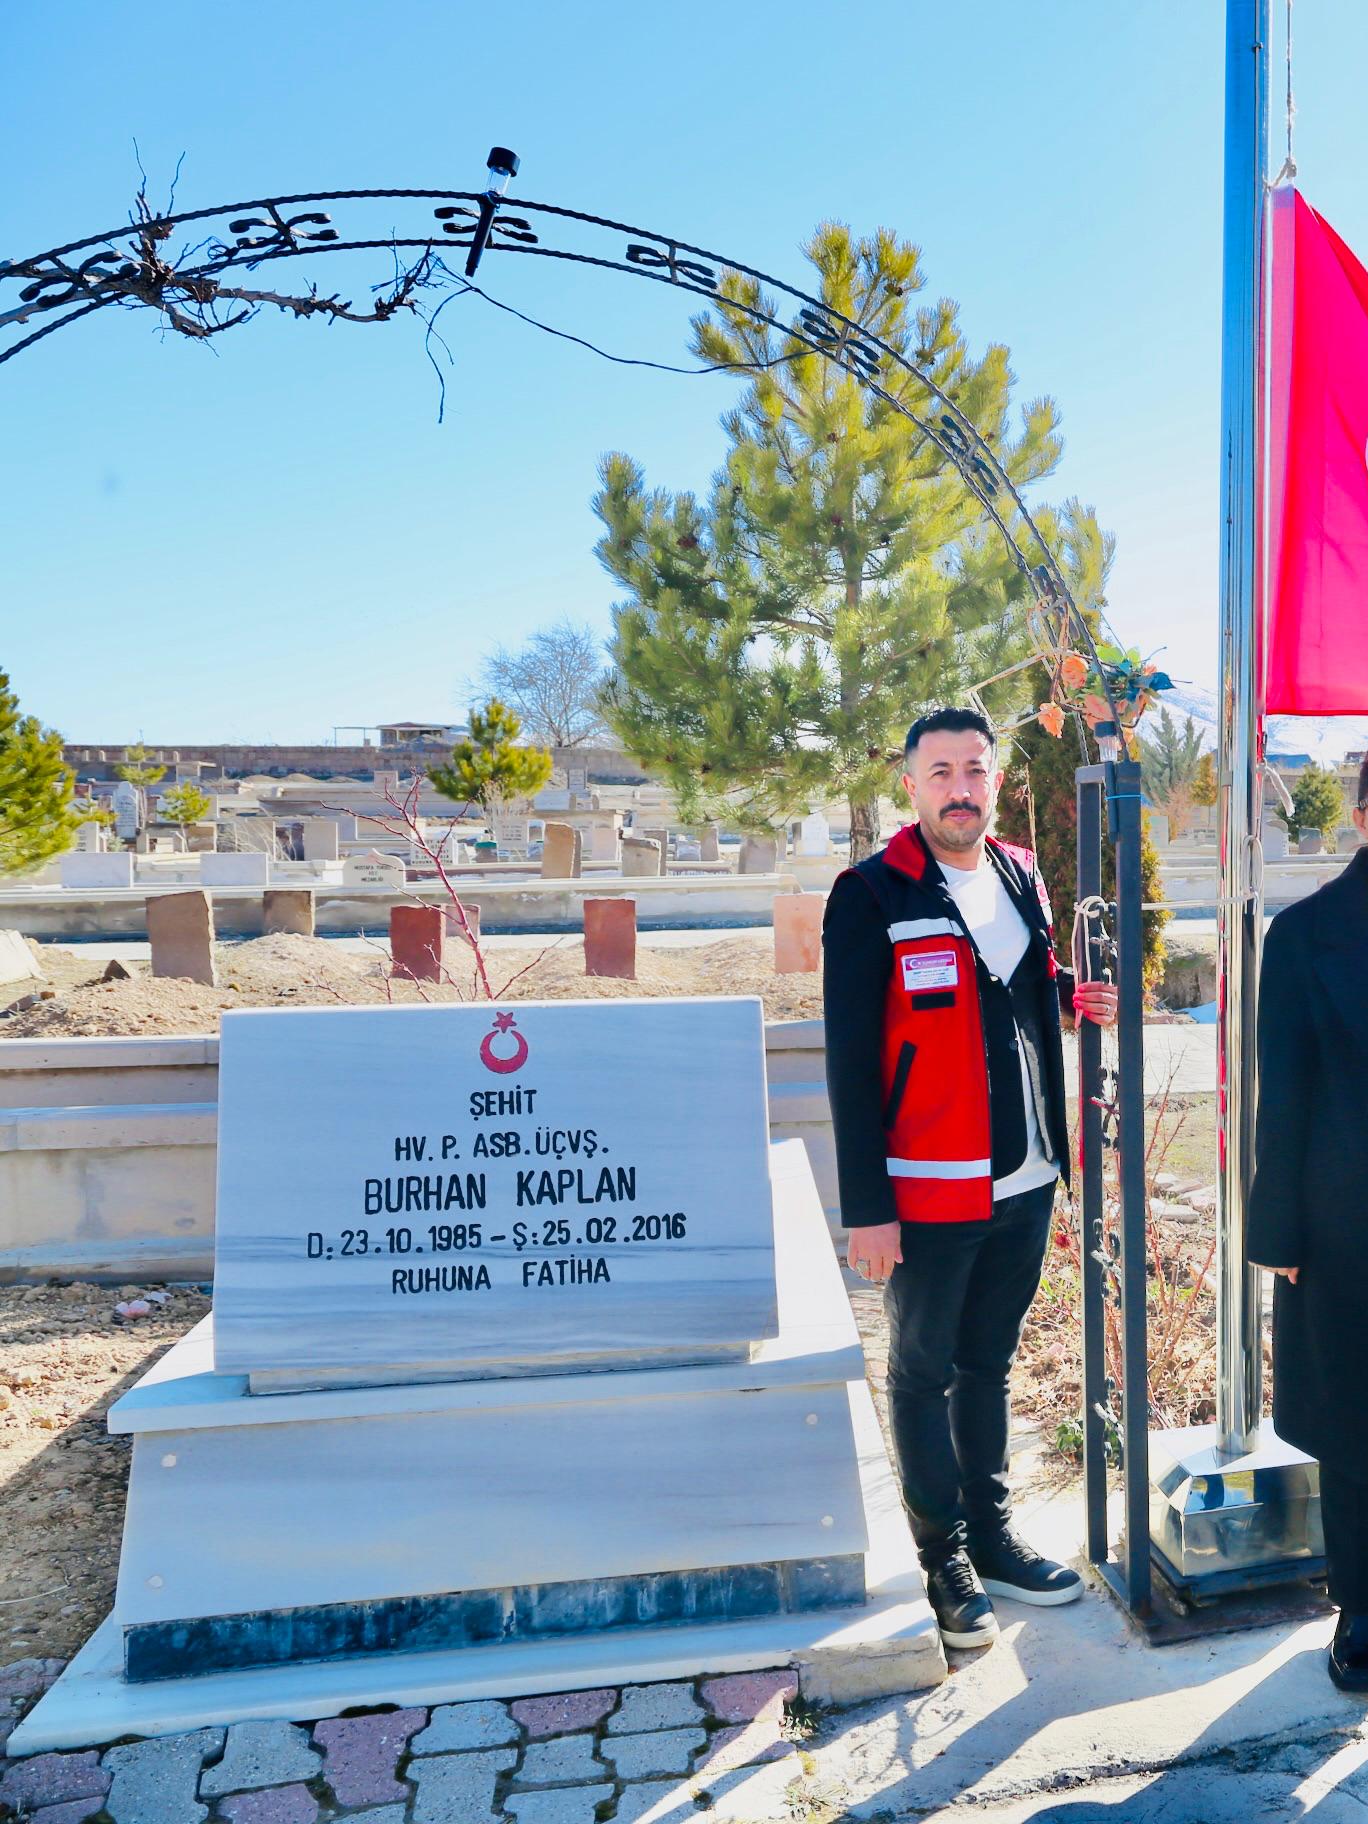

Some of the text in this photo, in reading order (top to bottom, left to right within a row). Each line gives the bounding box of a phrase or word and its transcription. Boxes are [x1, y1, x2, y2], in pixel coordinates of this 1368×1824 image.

[469, 1084, 538, 1122] ŞEHİT
[394, 1135, 434, 1162] HV.
[441, 1134, 461, 1160] P.
[364, 1166, 636, 1216] BURHAN KAPLAN
[392, 1253, 611, 1295] RUHUNA FATİHA
